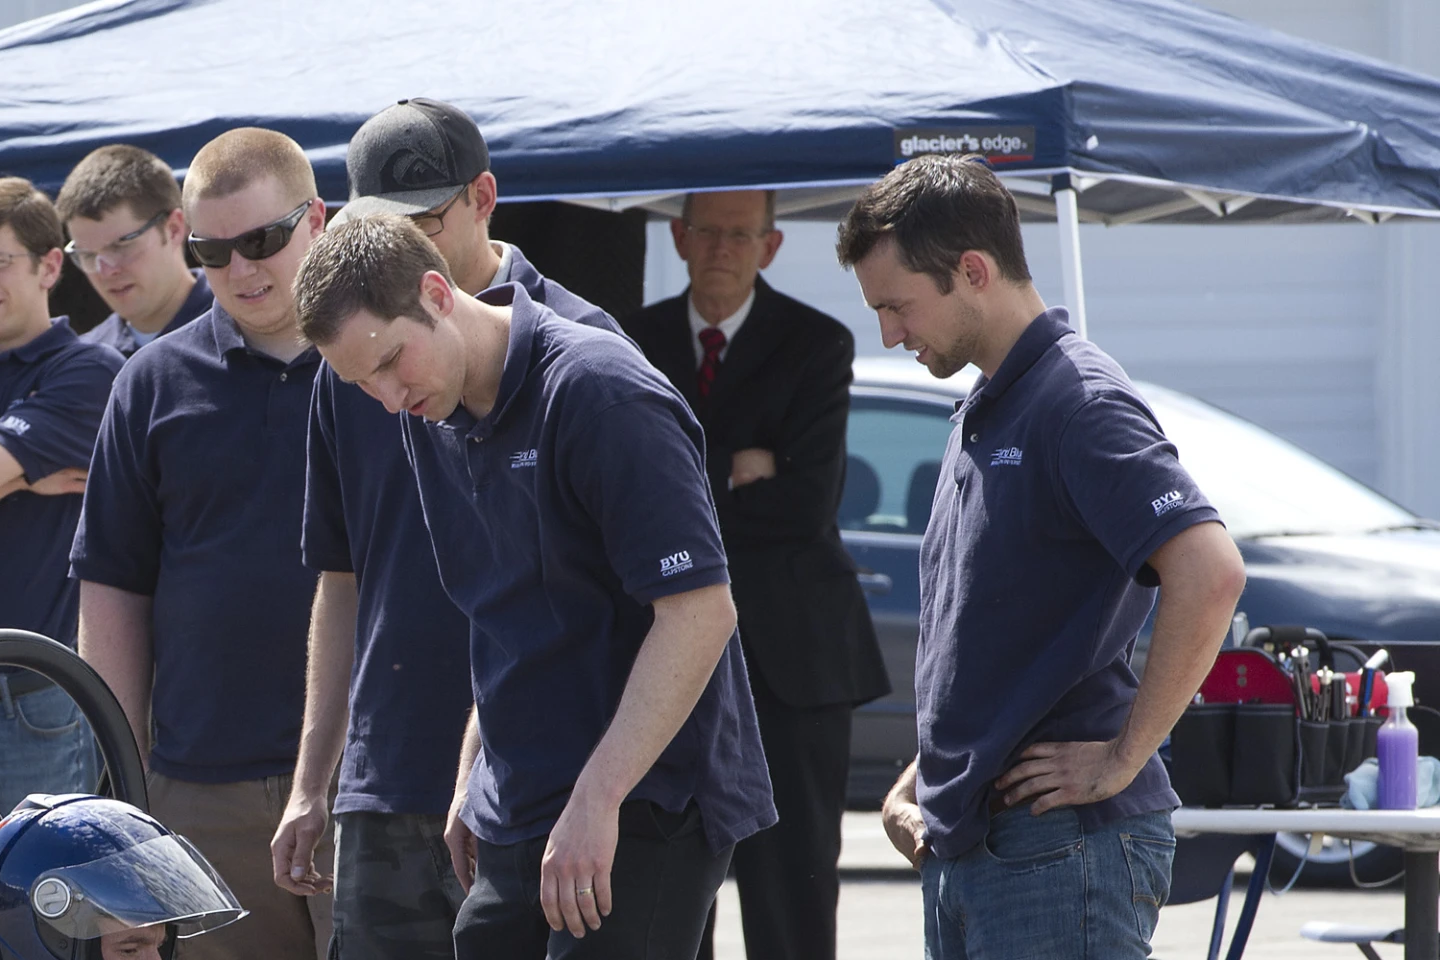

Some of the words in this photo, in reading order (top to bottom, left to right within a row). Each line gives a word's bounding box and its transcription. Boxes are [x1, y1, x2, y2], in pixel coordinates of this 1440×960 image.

[901, 134, 979, 155] glacier's
[1151, 490, 1181, 511] BYU
[660, 550, 690, 569] BYU
